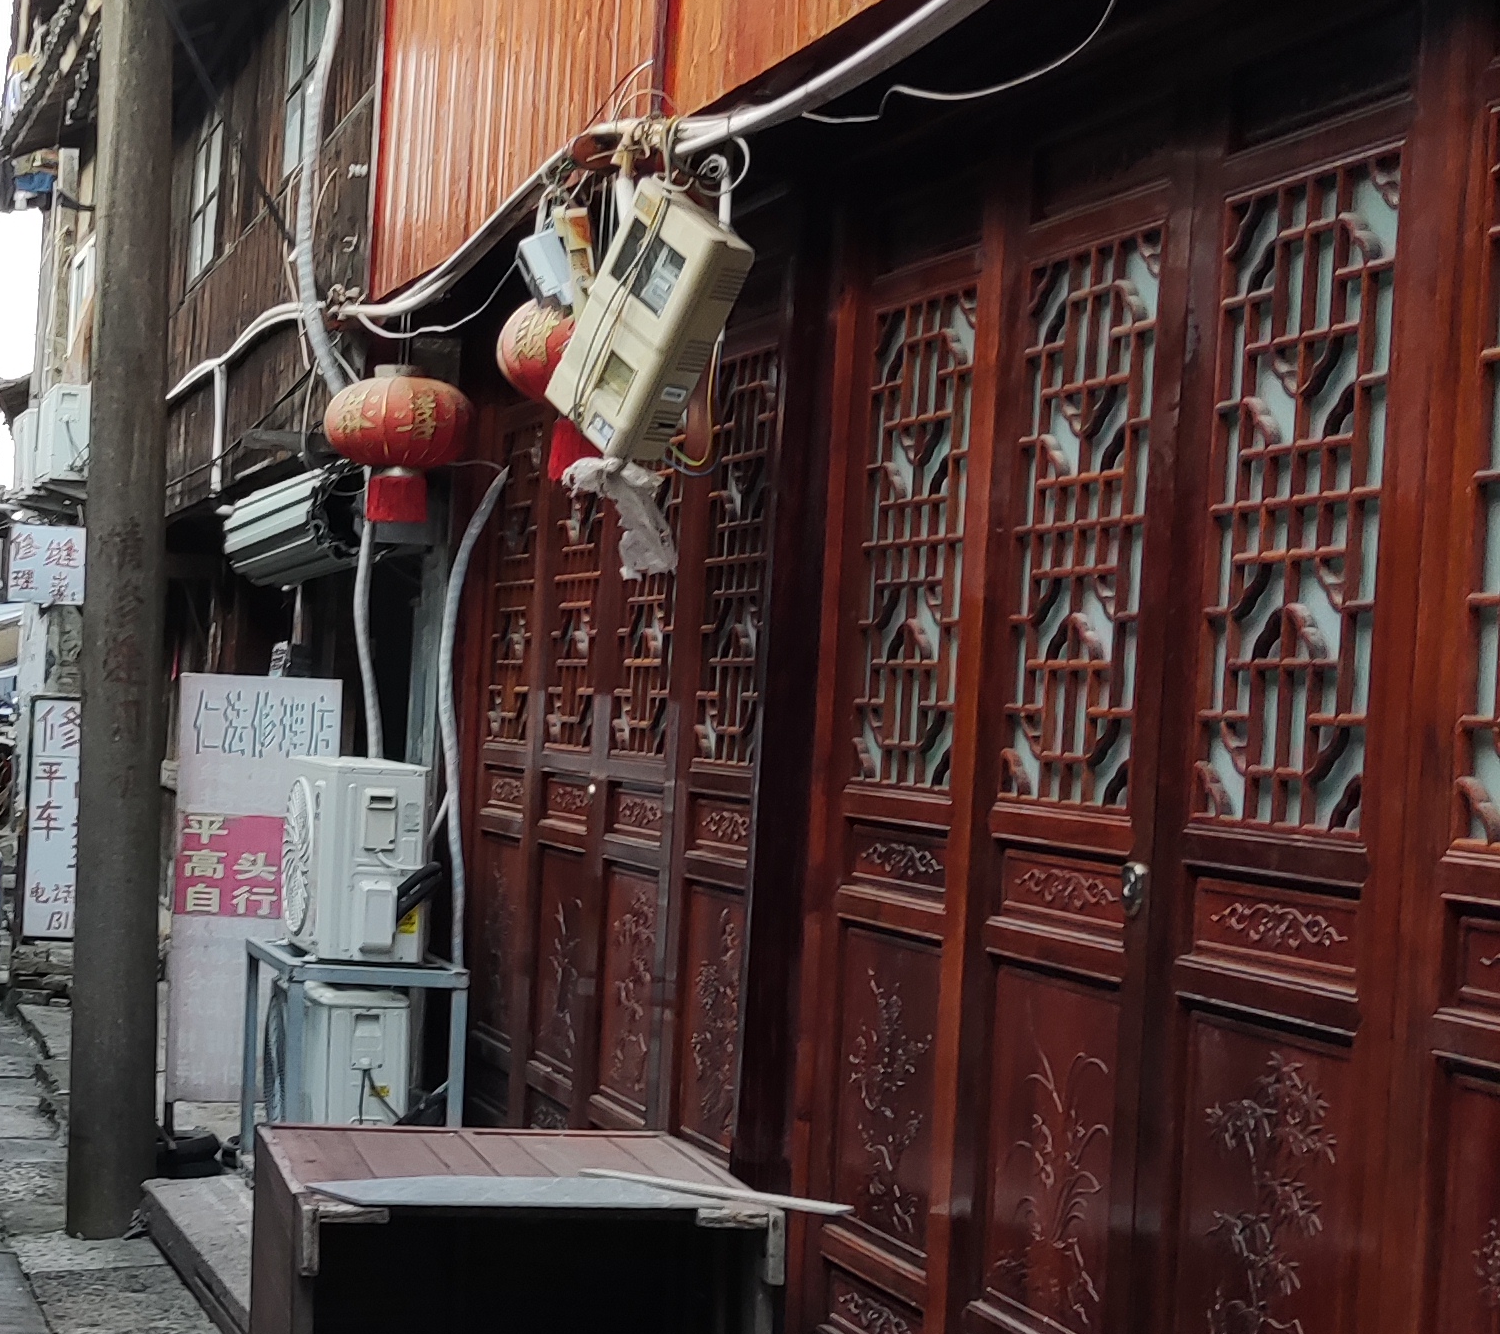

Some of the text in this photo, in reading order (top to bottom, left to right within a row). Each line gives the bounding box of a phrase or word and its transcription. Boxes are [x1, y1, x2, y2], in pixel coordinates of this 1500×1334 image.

[32, 762, 67, 842] 平车
[183, 815, 229, 845] 平
[185, 884, 278, 916] 自行
